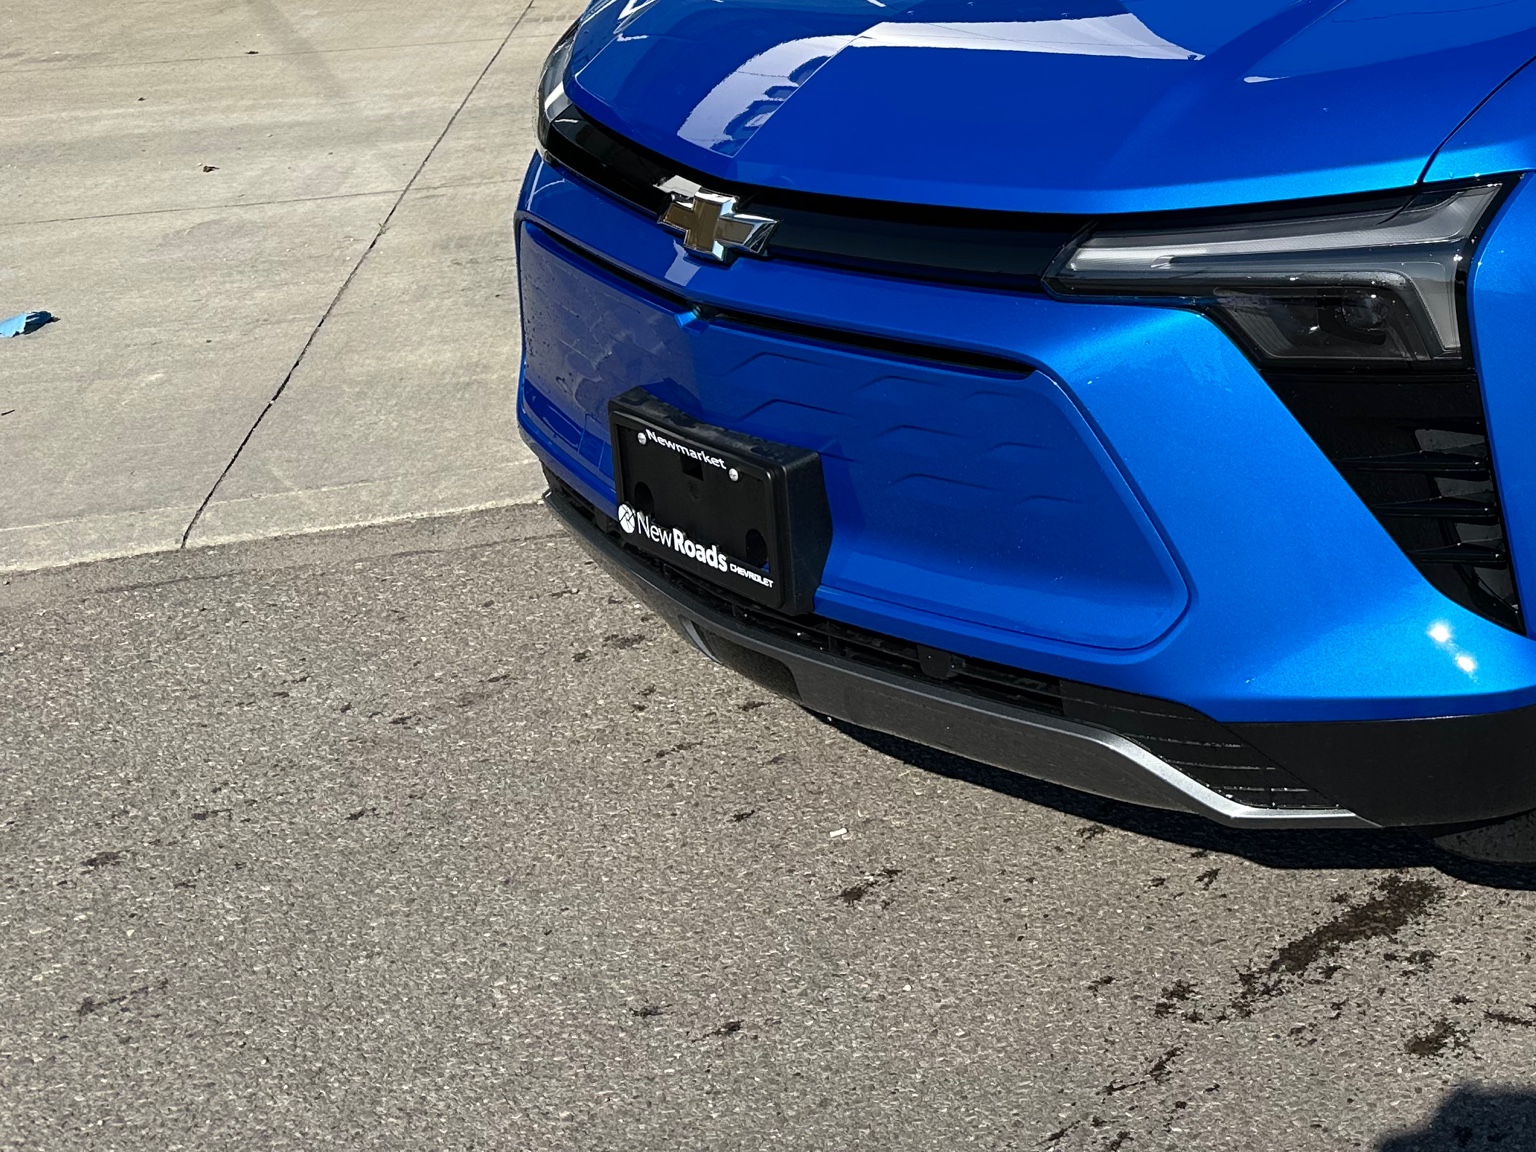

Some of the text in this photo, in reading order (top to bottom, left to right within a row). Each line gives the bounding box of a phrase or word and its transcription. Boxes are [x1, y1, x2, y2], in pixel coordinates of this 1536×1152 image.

[646, 429, 727, 470] Newmarket
[637, 511, 774, 588] NewRoads CHEVROLET
